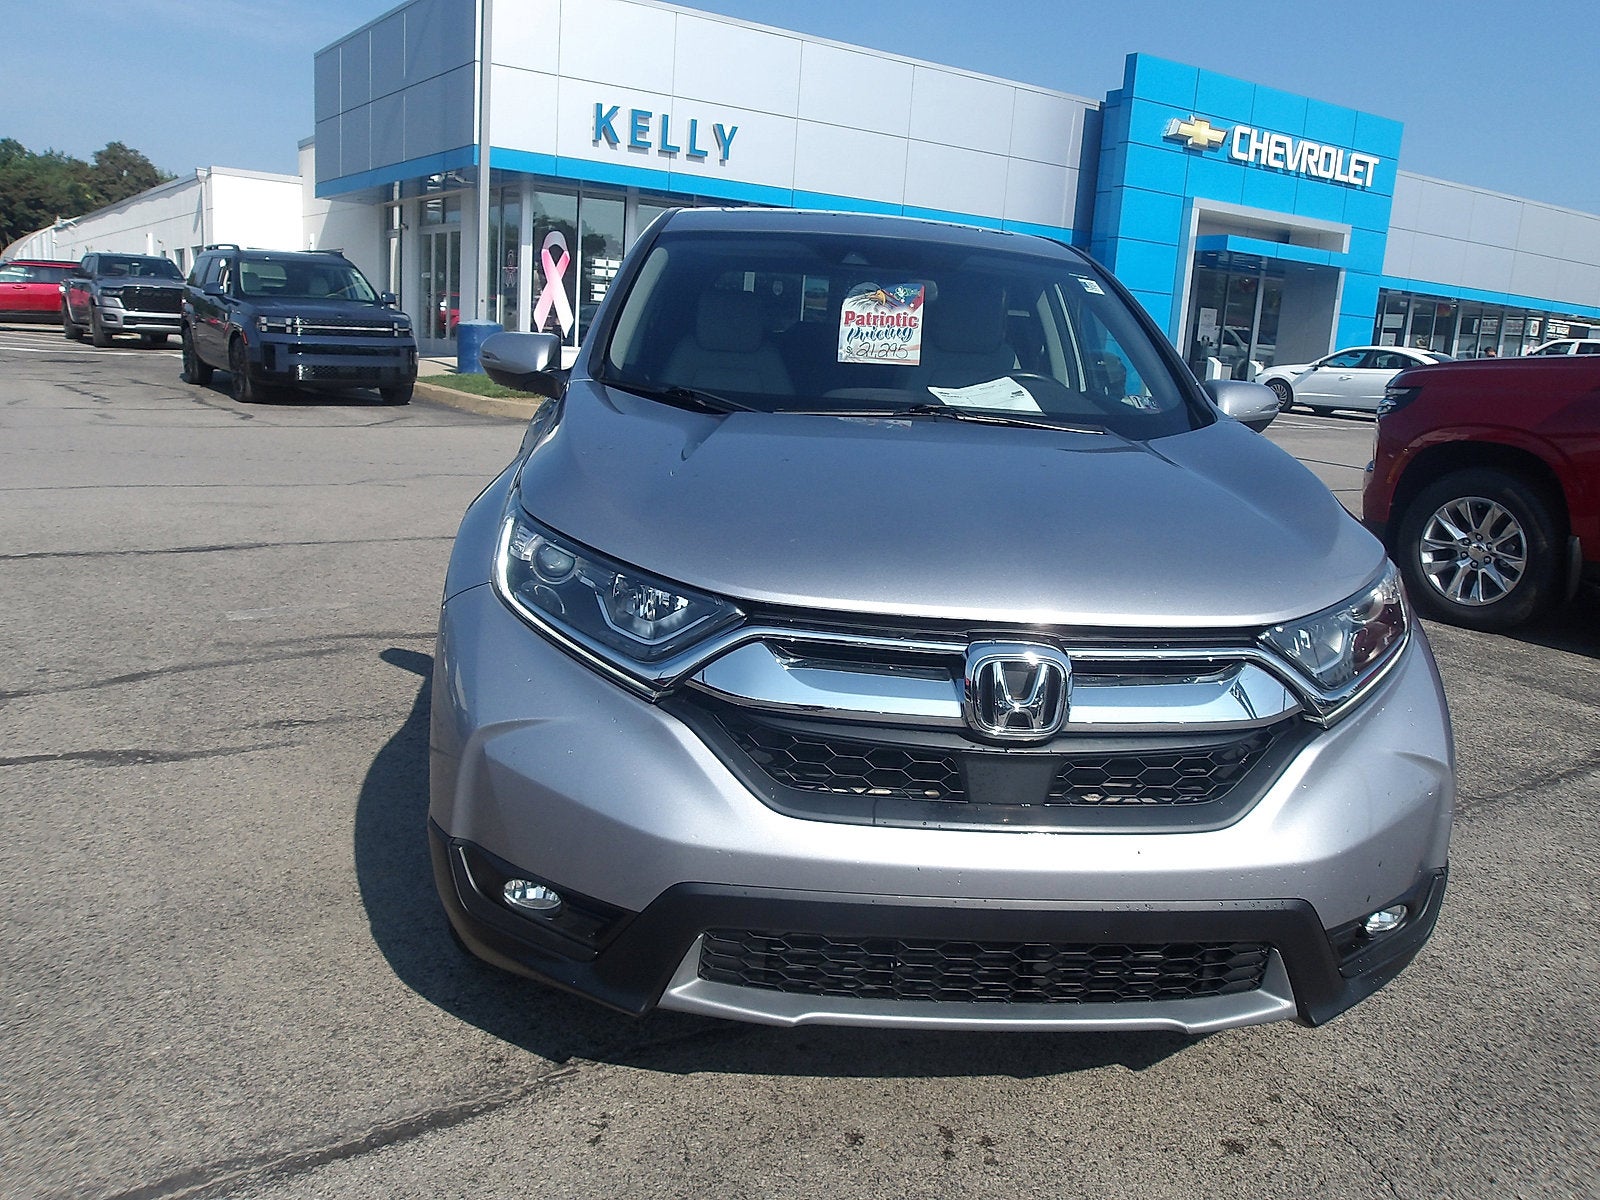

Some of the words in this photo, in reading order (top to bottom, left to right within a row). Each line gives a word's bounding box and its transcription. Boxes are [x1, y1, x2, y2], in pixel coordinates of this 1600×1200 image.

[592, 102, 739, 162] KELLY
[1230, 125, 1380, 188] CHEVROLET
[843, 310, 919, 328] Patriotic
